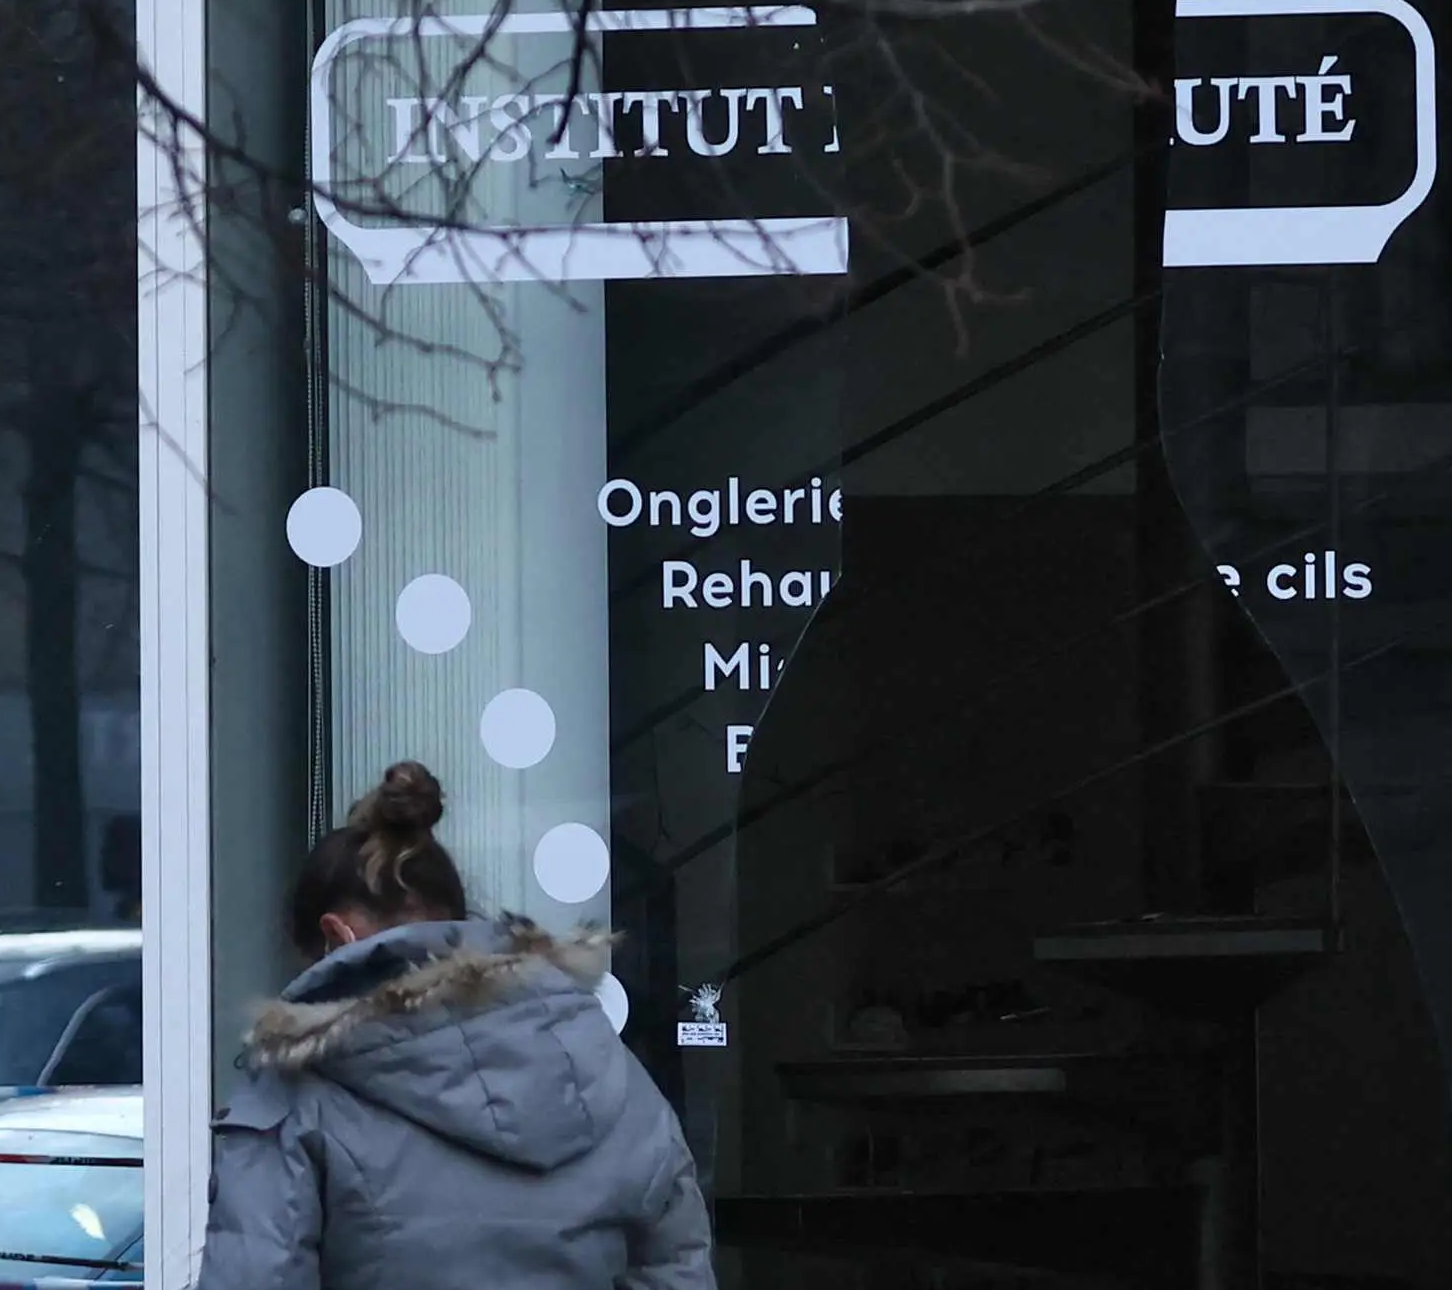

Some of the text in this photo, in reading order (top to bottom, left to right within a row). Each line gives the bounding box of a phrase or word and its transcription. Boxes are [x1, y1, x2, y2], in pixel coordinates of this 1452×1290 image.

[387, 86, 805, 165] INSTITUT
[1168, 55, 1358, 147] UTÉ
[1266, 550, 1373, 600] cils
[704, 642, 786, 691] Mi
